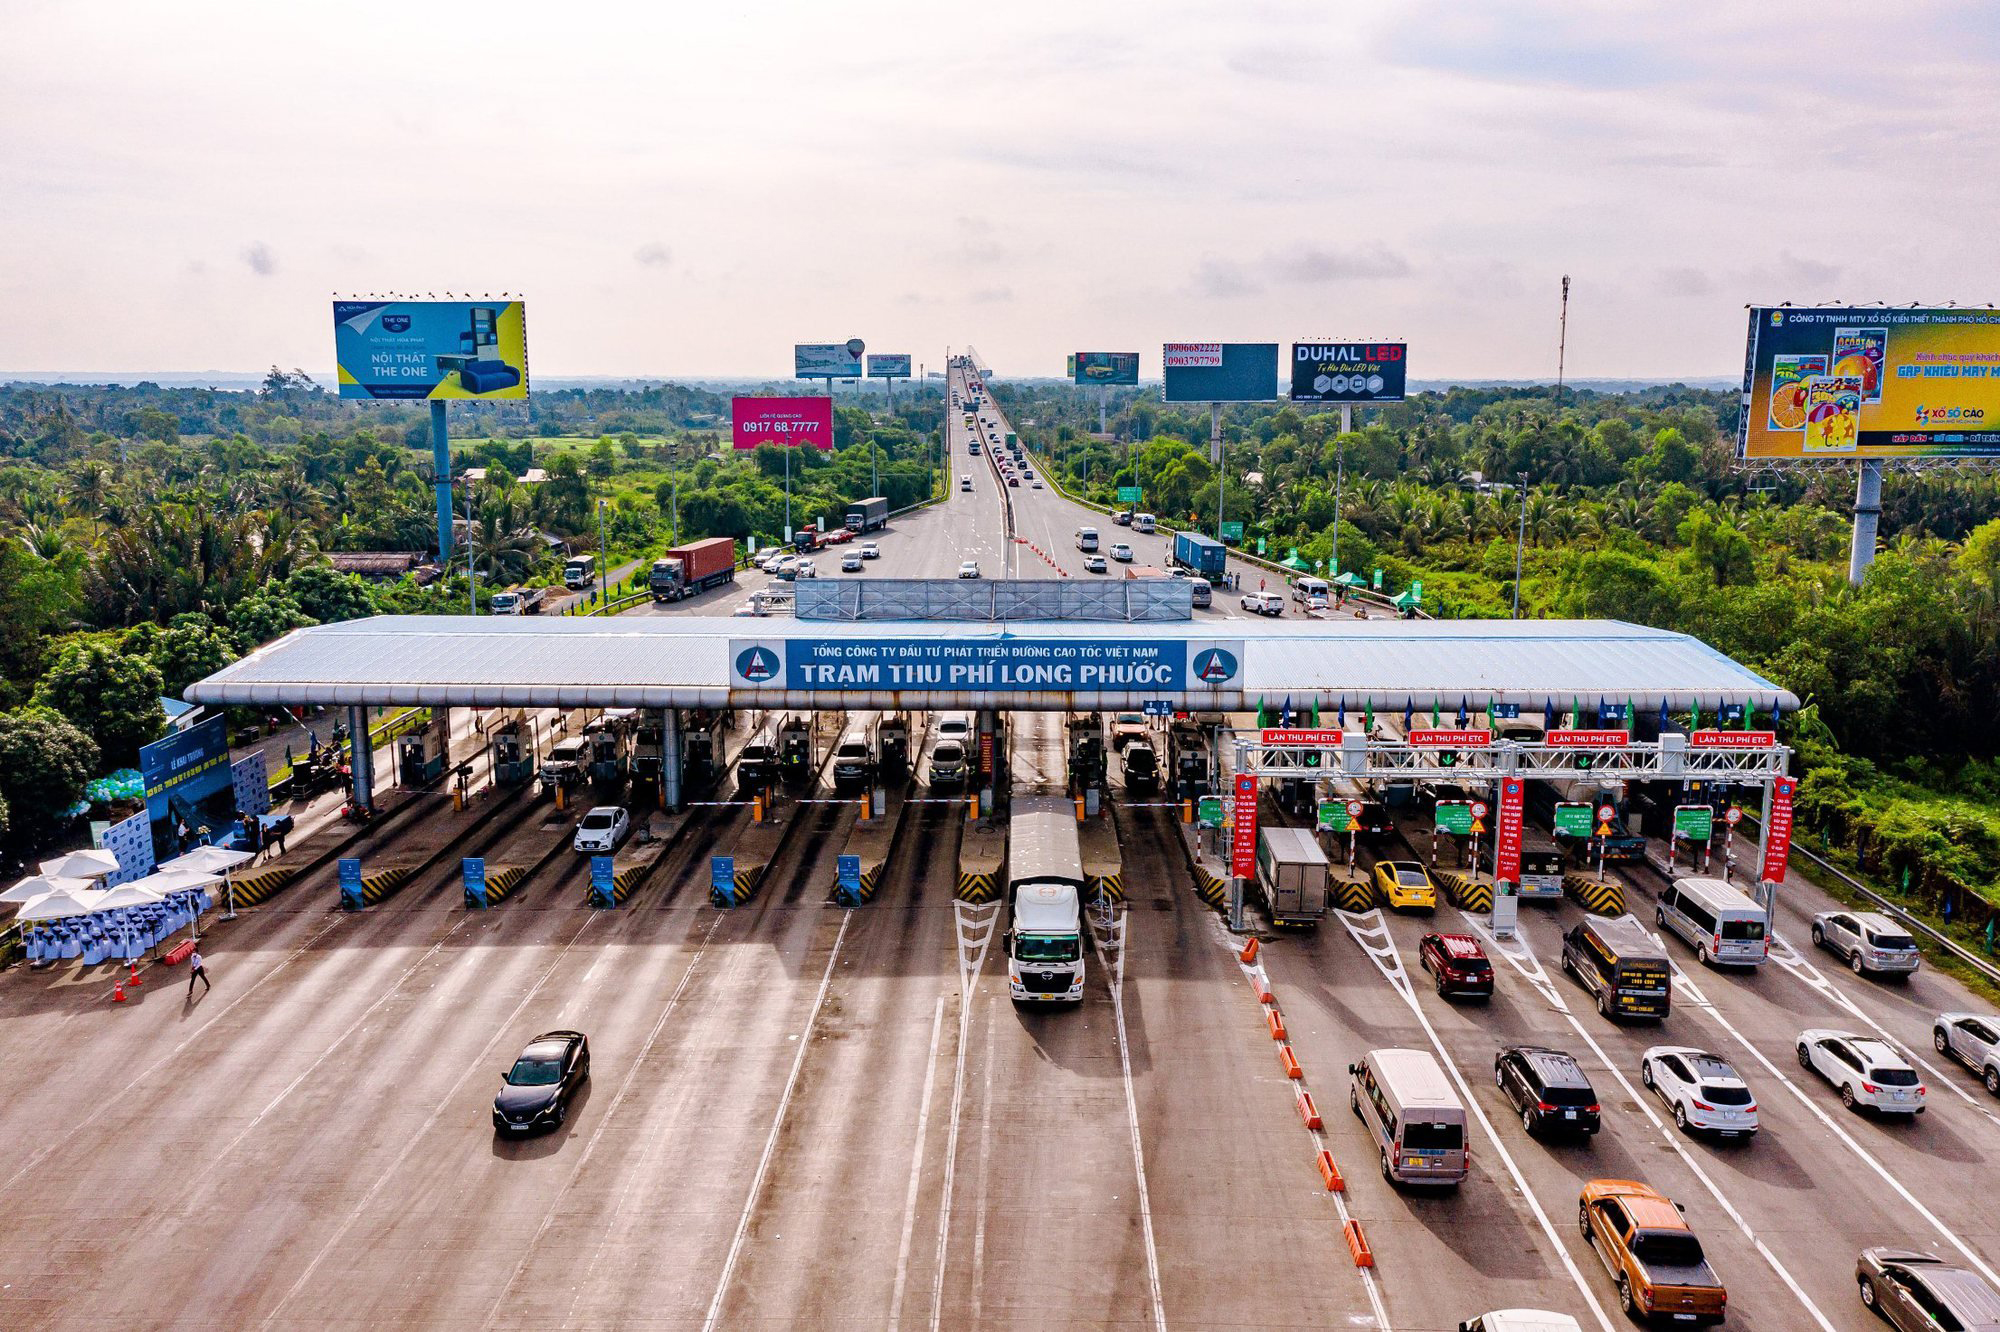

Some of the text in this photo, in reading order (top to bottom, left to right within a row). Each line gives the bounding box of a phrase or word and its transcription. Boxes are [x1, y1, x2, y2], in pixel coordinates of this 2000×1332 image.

[1789, 314, 1814, 323] CÔNG
[1815, 315, 1825, 323] TY
[1826, 315, 1847, 323] TNHH
[1849, 315, 1866, 323] MTV
[1867, 312, 1879, 323] XỔ
[1880, 312, 1892, 323] SỐ
[1892, 312, 1910, 323] KIẾN
[1911, 312, 1929, 323] THIẾT
[1931, 314, 1957, 323] THÀNH
[1958, 312, 1975, 323] PHỐ
[1976, 312, 1987, 323] HỒ
[1168, 344, 1220, 352] 0906682222
[371, 352, 426, 366] NỘI THẤT
[1365, 346, 1403, 362] LED
[1168, 357, 1220, 366] 0903797799
[372, 367, 428, 377] THE ONE
[1352, 362, 1367, 373] LED
[1897, 364, 1921, 378] GẶP
[1923, 363, 1959, 378] NHIỀU
[1931, 405, 1984, 418] XỔ SỐ CÀO
[743, 421, 819, 432] 0917 68 7777
[812, 642, 1158, 660] TỔNG CÔNG TY ĐẦU TƯ PHÁT TRIỂN ĐƯỜNG CAO TỐC VIỆT NAM
[800, 660, 1173, 688] TRẠM THU PHÍ LONG PHƯỚC
[1268, 732, 1286, 741] LÀN
[1306, 732, 1319, 741] PHÍ
[1416, 734, 1432, 742] LÀN
[1452, 734, 1466, 742] PHÍ
[1553, 734, 1570, 742] LÀN
[1590, 734, 1604, 742] PHÍ
[1699, 735, 1716, 743] LÀN
[1736, 735, 1750, 743] PHÍ
